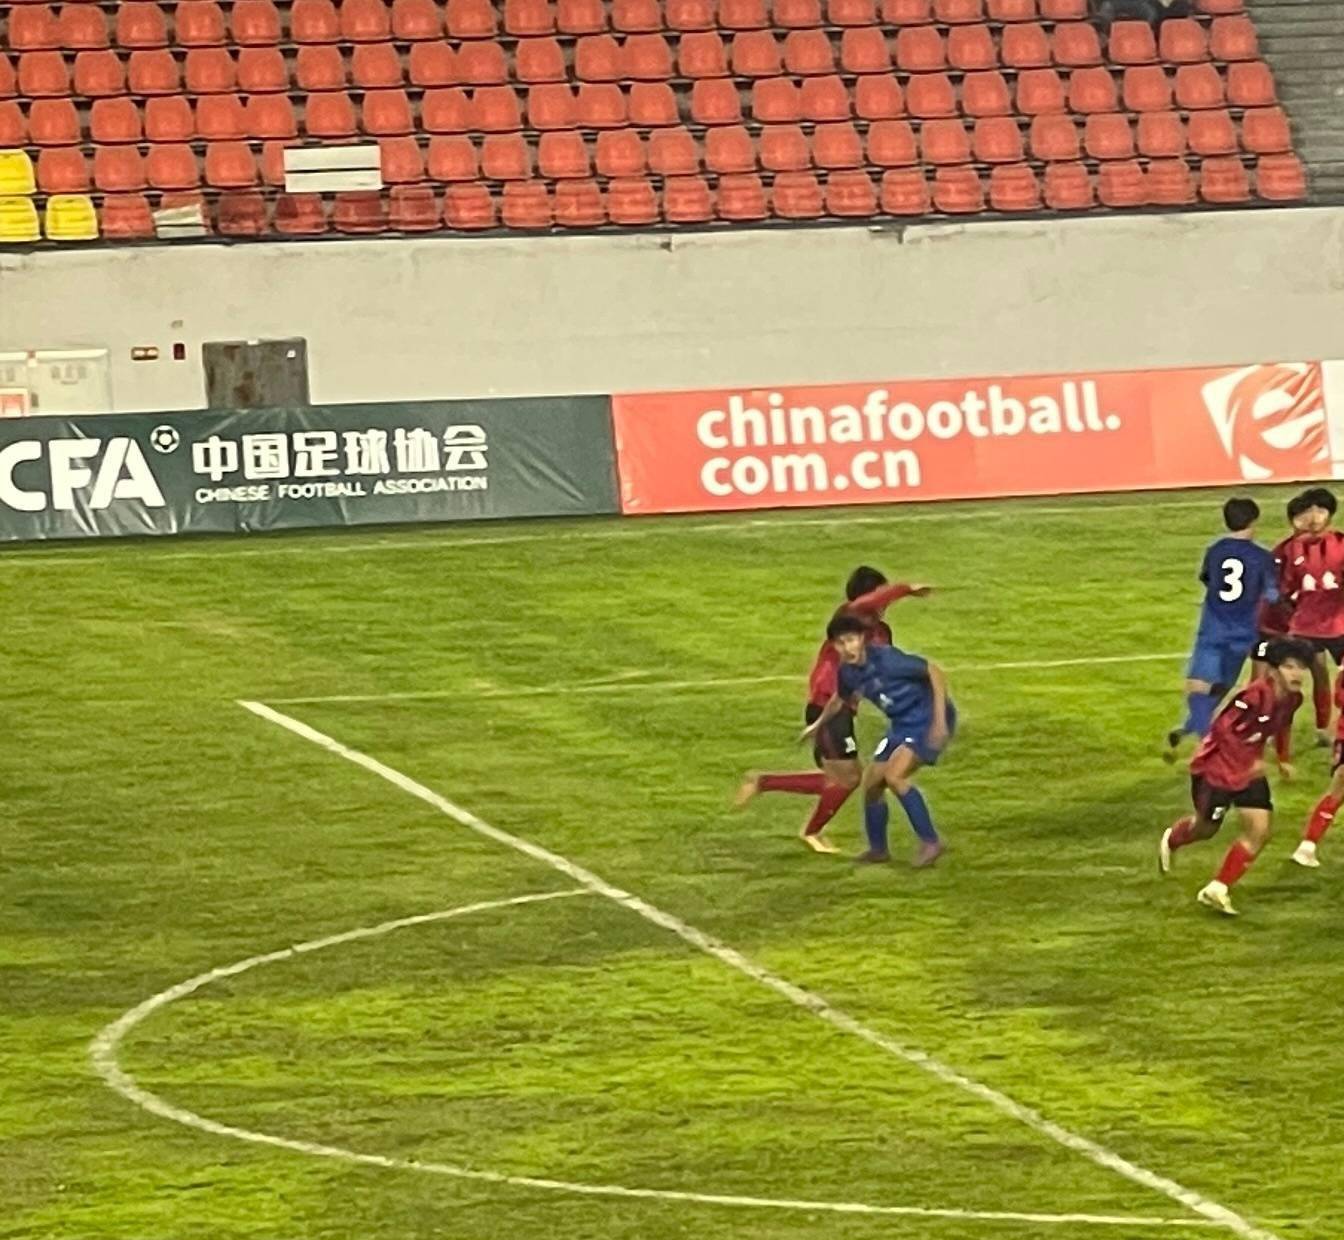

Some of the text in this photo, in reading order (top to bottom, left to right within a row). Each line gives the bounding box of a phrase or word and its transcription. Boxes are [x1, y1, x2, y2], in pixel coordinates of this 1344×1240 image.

[697, 381, 1121, 448] chinafootball.
[0, 437, 166, 511] CFA
[192, 425, 488, 481] 中国足球协会
[700, 448, 920, 495] com.cn
[195, 476, 488, 503] CHINESE FOOTBALL ASSOCIATION
[1219, 558, 1244, 602] 3
